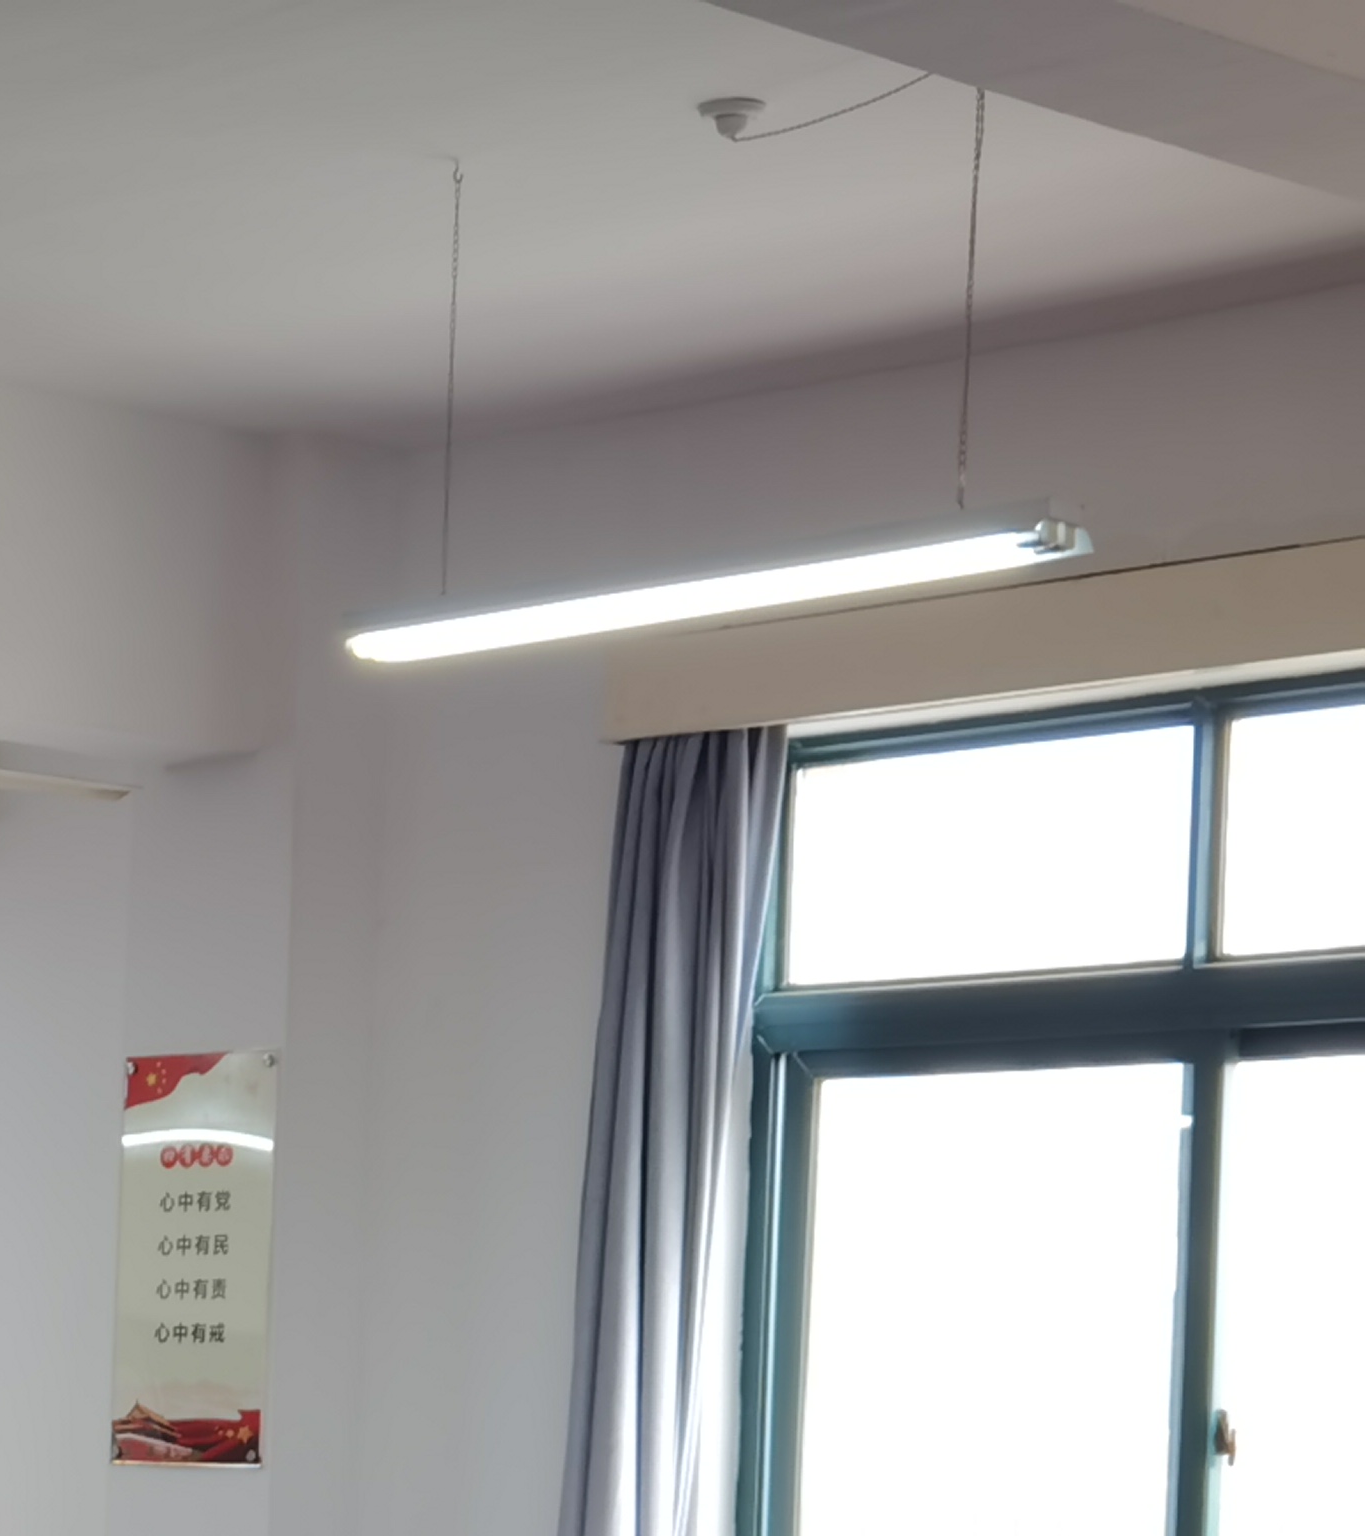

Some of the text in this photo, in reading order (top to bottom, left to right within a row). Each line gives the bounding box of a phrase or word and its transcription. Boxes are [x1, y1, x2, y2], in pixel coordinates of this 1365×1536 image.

[159, 1190, 231, 1212] 心中有党
[157, 1234, 229, 1256] 心中有民
[156, 1278, 227, 1300] 心中有责
[154, 1322, 226, 1344] 心中有戒
